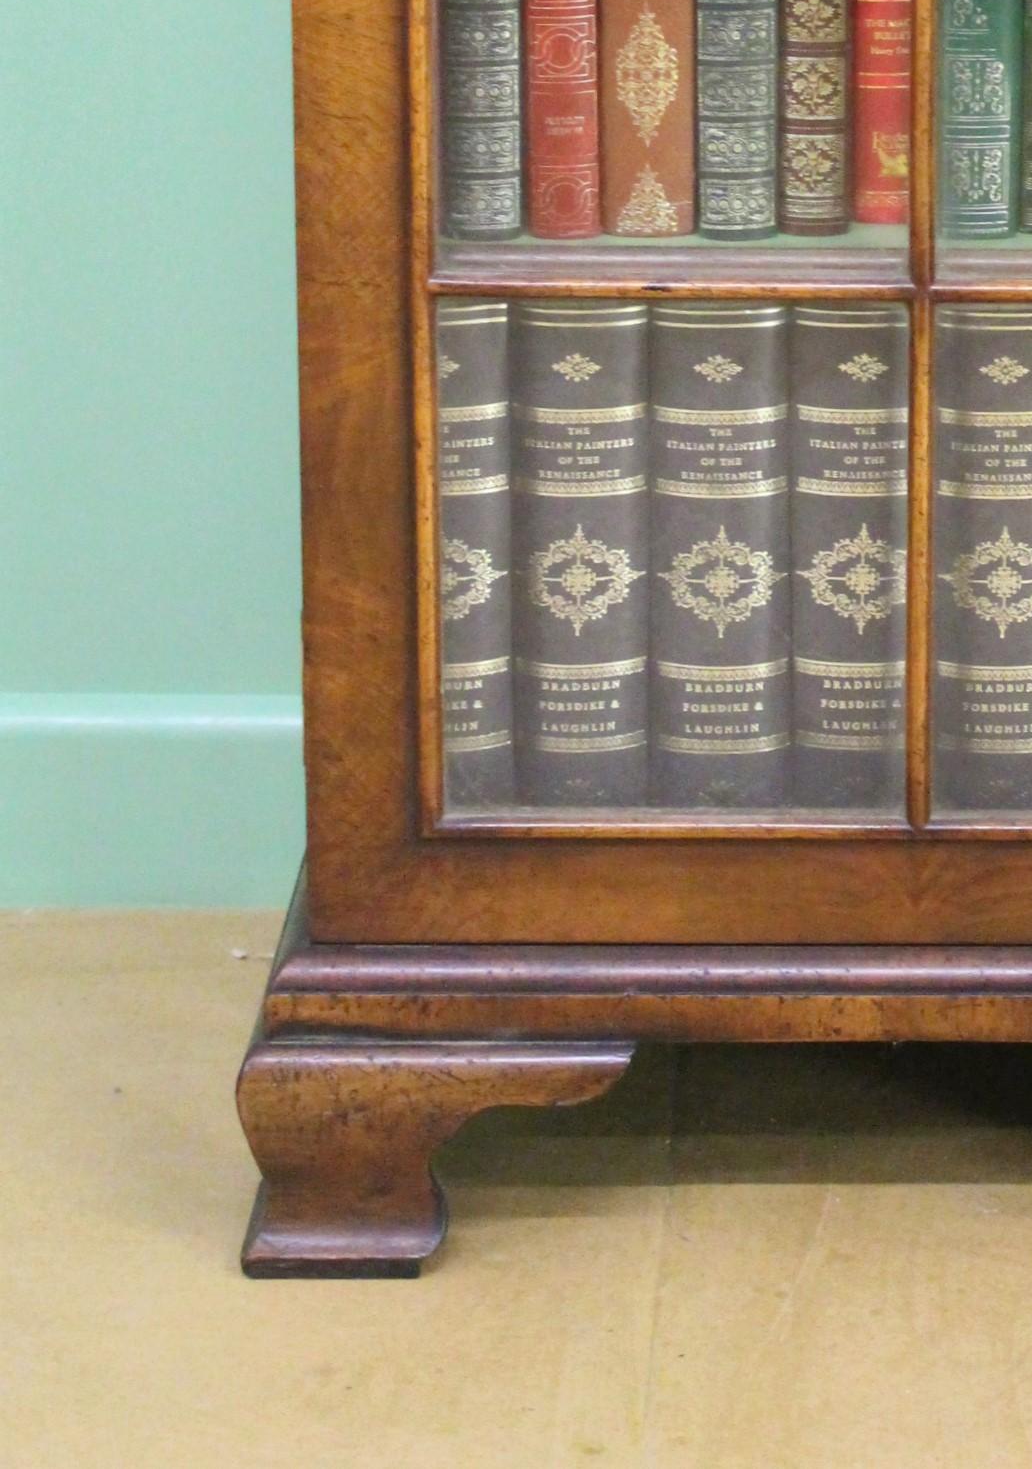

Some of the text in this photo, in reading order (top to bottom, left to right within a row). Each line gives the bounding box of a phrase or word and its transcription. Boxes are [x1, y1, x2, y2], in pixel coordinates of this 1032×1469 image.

[568, 427, 591, 435] THE
[709, 427, 733, 436] THE
[854, 427, 877, 435] THE
[994, 429, 1018, 438] THE
[442, 437, 495, 448] AINTERS
[576, 438, 635, 450] PAINTERS
[667, 439, 777, 451] ITALIAN PAINTERS
[809, 438, 906, 450] ITALIAN PAINTE
[557, 456, 601, 465] OF THE
[701, 457, 743, 466] OF THE
[843, 456, 887, 465] OF THE
[985, 459, 1027, 467] OF THE
[538, 468, 621, 479] RENAISSANCE
[680, 470, 764, 481] RENAISSANCE
[541, 680, 621, 691] BRADBURN
[685, 682, 765, 693] BRADBURN
[539, 699, 621, 711] FORSDIKE &
[682, 701, 764, 713] FORSDIKE &
[962, 702, 1030, 712] FORSDIKE
[541, 721, 616, 732] LAUGHLIN
[685, 723, 760, 735] LAUGHLIN
